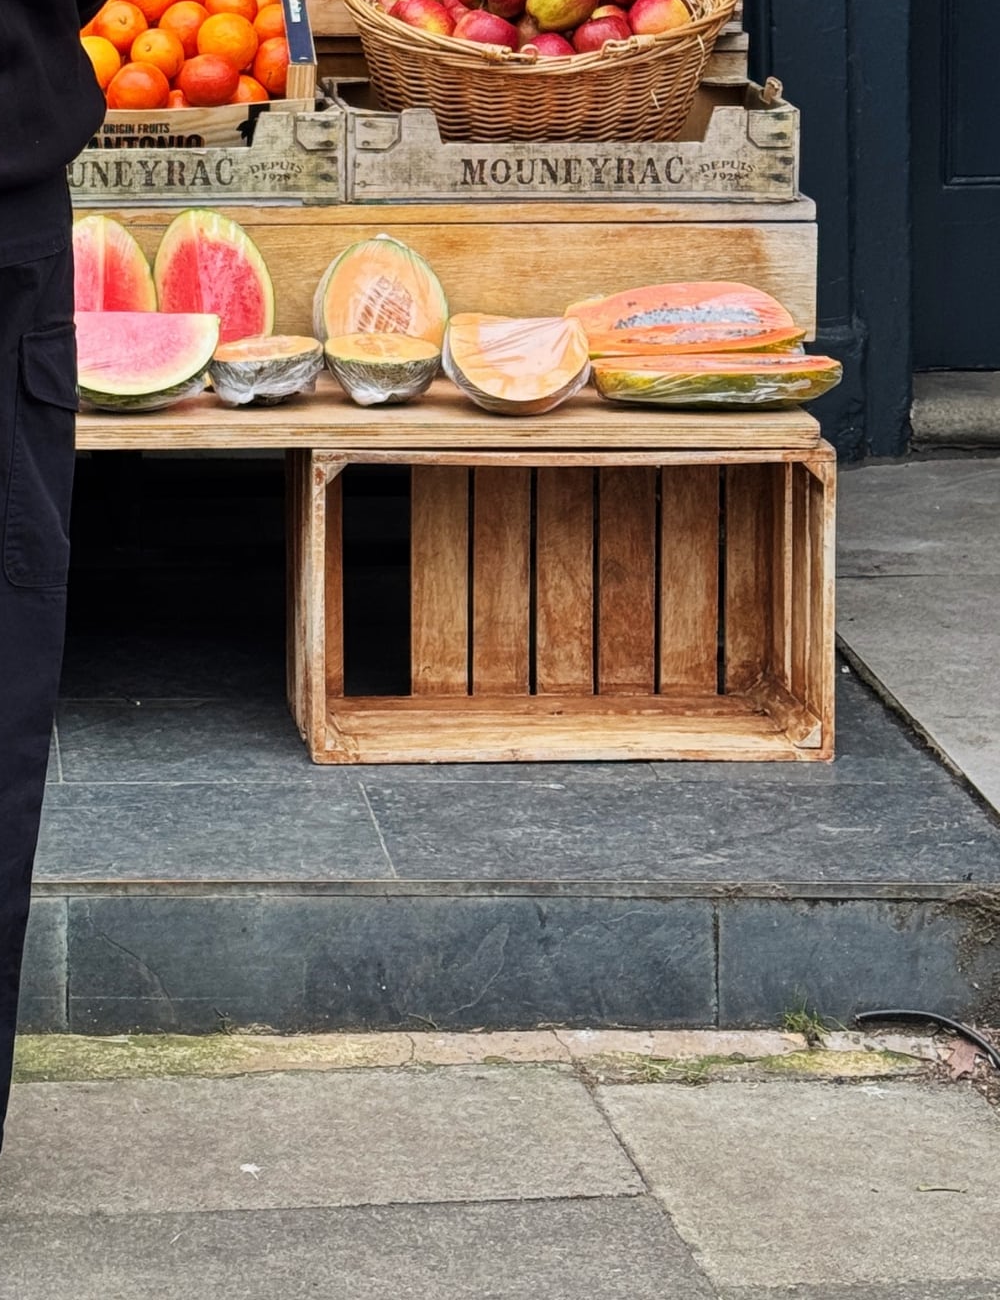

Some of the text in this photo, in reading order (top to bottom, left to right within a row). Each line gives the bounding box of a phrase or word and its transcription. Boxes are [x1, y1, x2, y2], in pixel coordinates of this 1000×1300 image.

[103, 122, 170, 134] ORIGIN FRUITS
[67, 157, 234, 188] UNEYRAC
[249, 161, 304, 174] DEPUIS
[460, 156, 685, 185] MOUNEYRAC
[699, 160, 756, 173] DEPUIS
